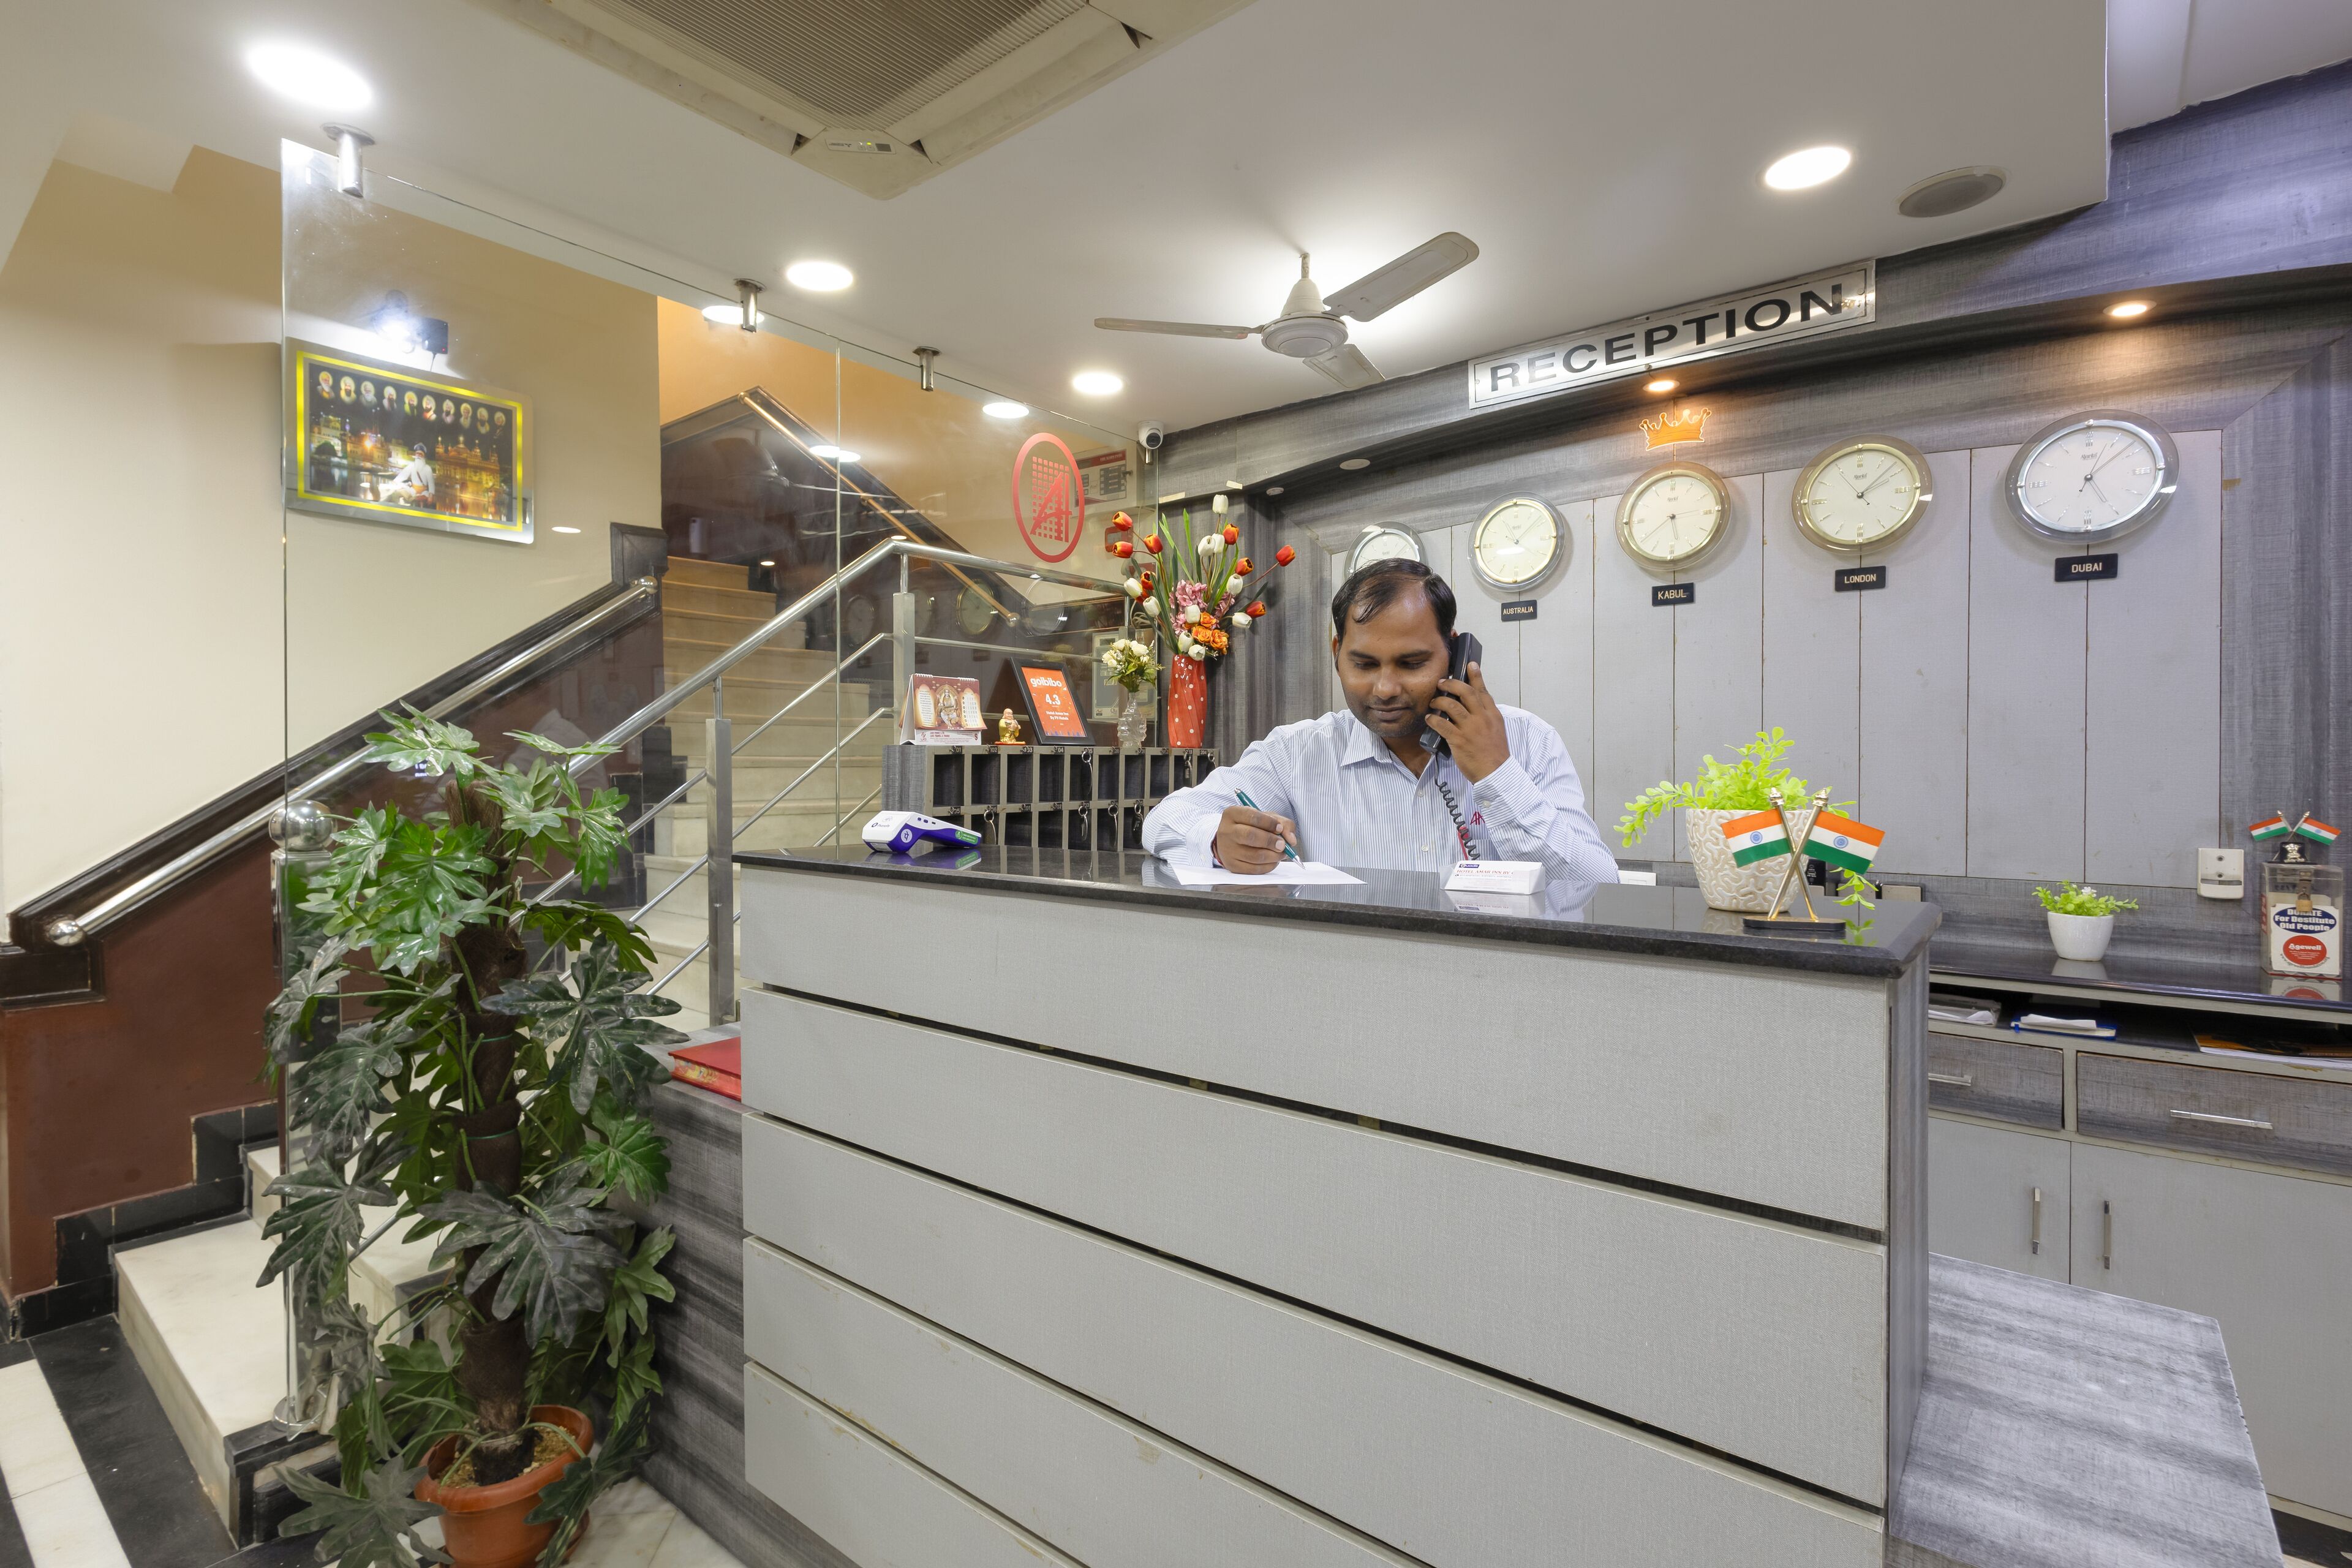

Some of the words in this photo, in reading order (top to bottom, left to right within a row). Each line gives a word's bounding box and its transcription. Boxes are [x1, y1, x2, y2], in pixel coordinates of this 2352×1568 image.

[1490, 283, 1842, 392] RECEPTION
[2071, 562, 2103, 573] DUBAI
[1844, 573, 1877, 584] LONDON
[1658, 589, 1687, 600] KABUL
[1503, 606, 1534, 615] AUSTRALIA
[1030, 677, 1062, 687] goibibo
[1045, 693, 1061, 705] 4.3
[2291, 916, 2335, 924] Destitute
